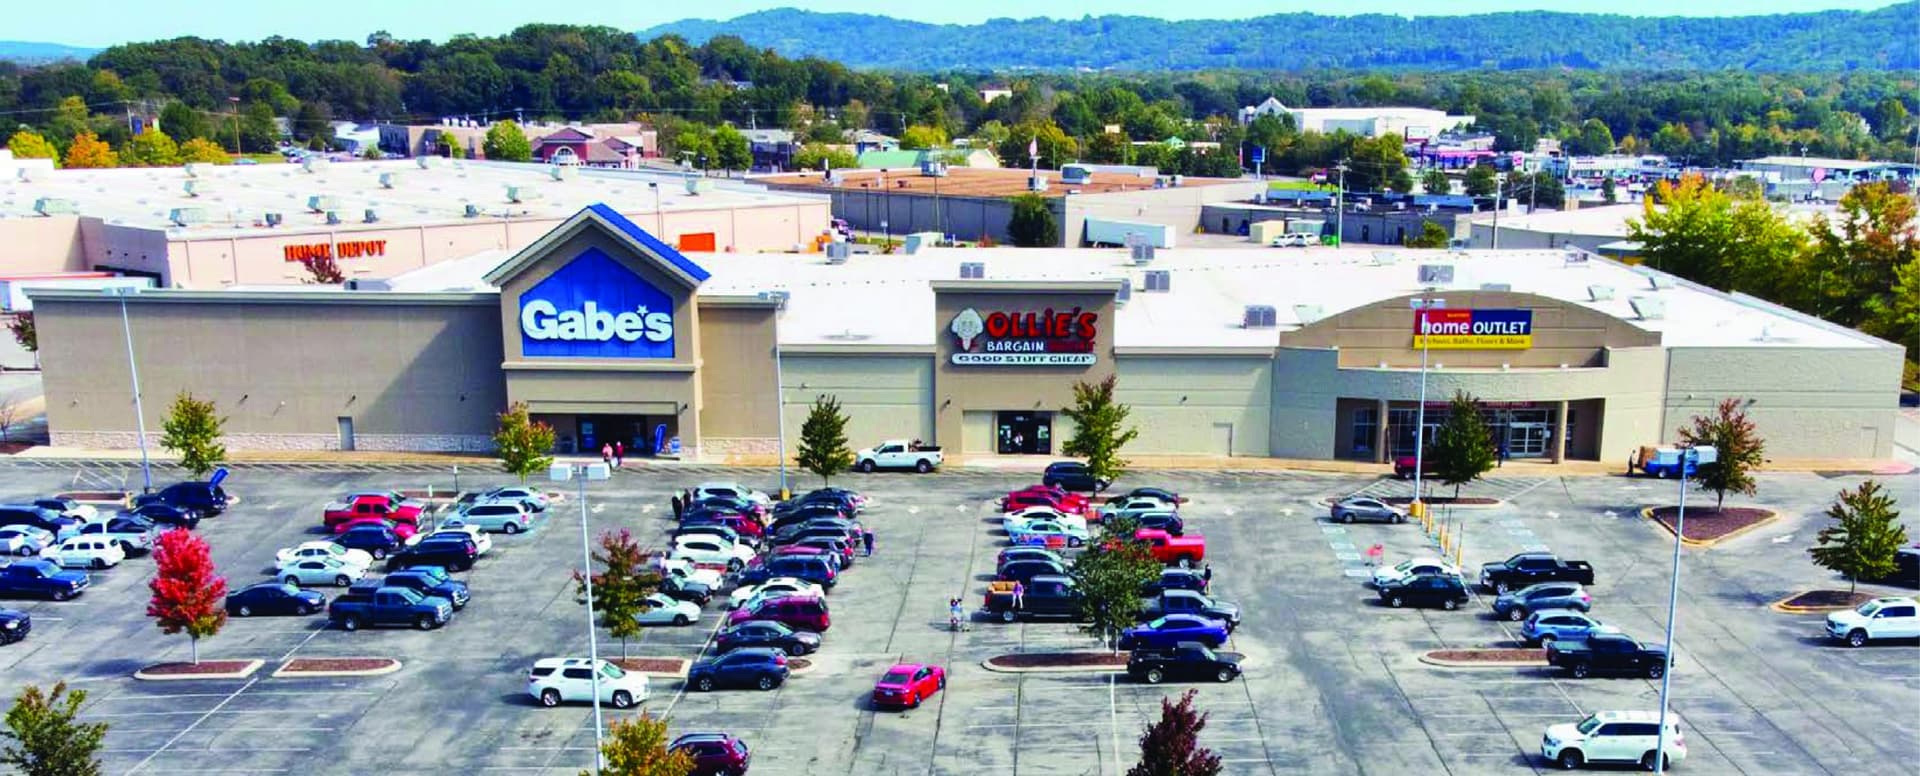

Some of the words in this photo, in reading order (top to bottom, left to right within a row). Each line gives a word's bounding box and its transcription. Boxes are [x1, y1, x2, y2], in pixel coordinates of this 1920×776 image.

[337, 240, 386, 258] DEPOT
[521, 299, 673, 342] Gabe's
[1421, 313, 1470, 334] home
[1472, 321, 1527, 334] OUTLET
[986, 341, 1045, 352] BARGAIN
[958, 355, 1002, 363] GOOD
[1005, 355, 1047, 363] STUFF
[1049, 355, 1090, 363] CHEAP
